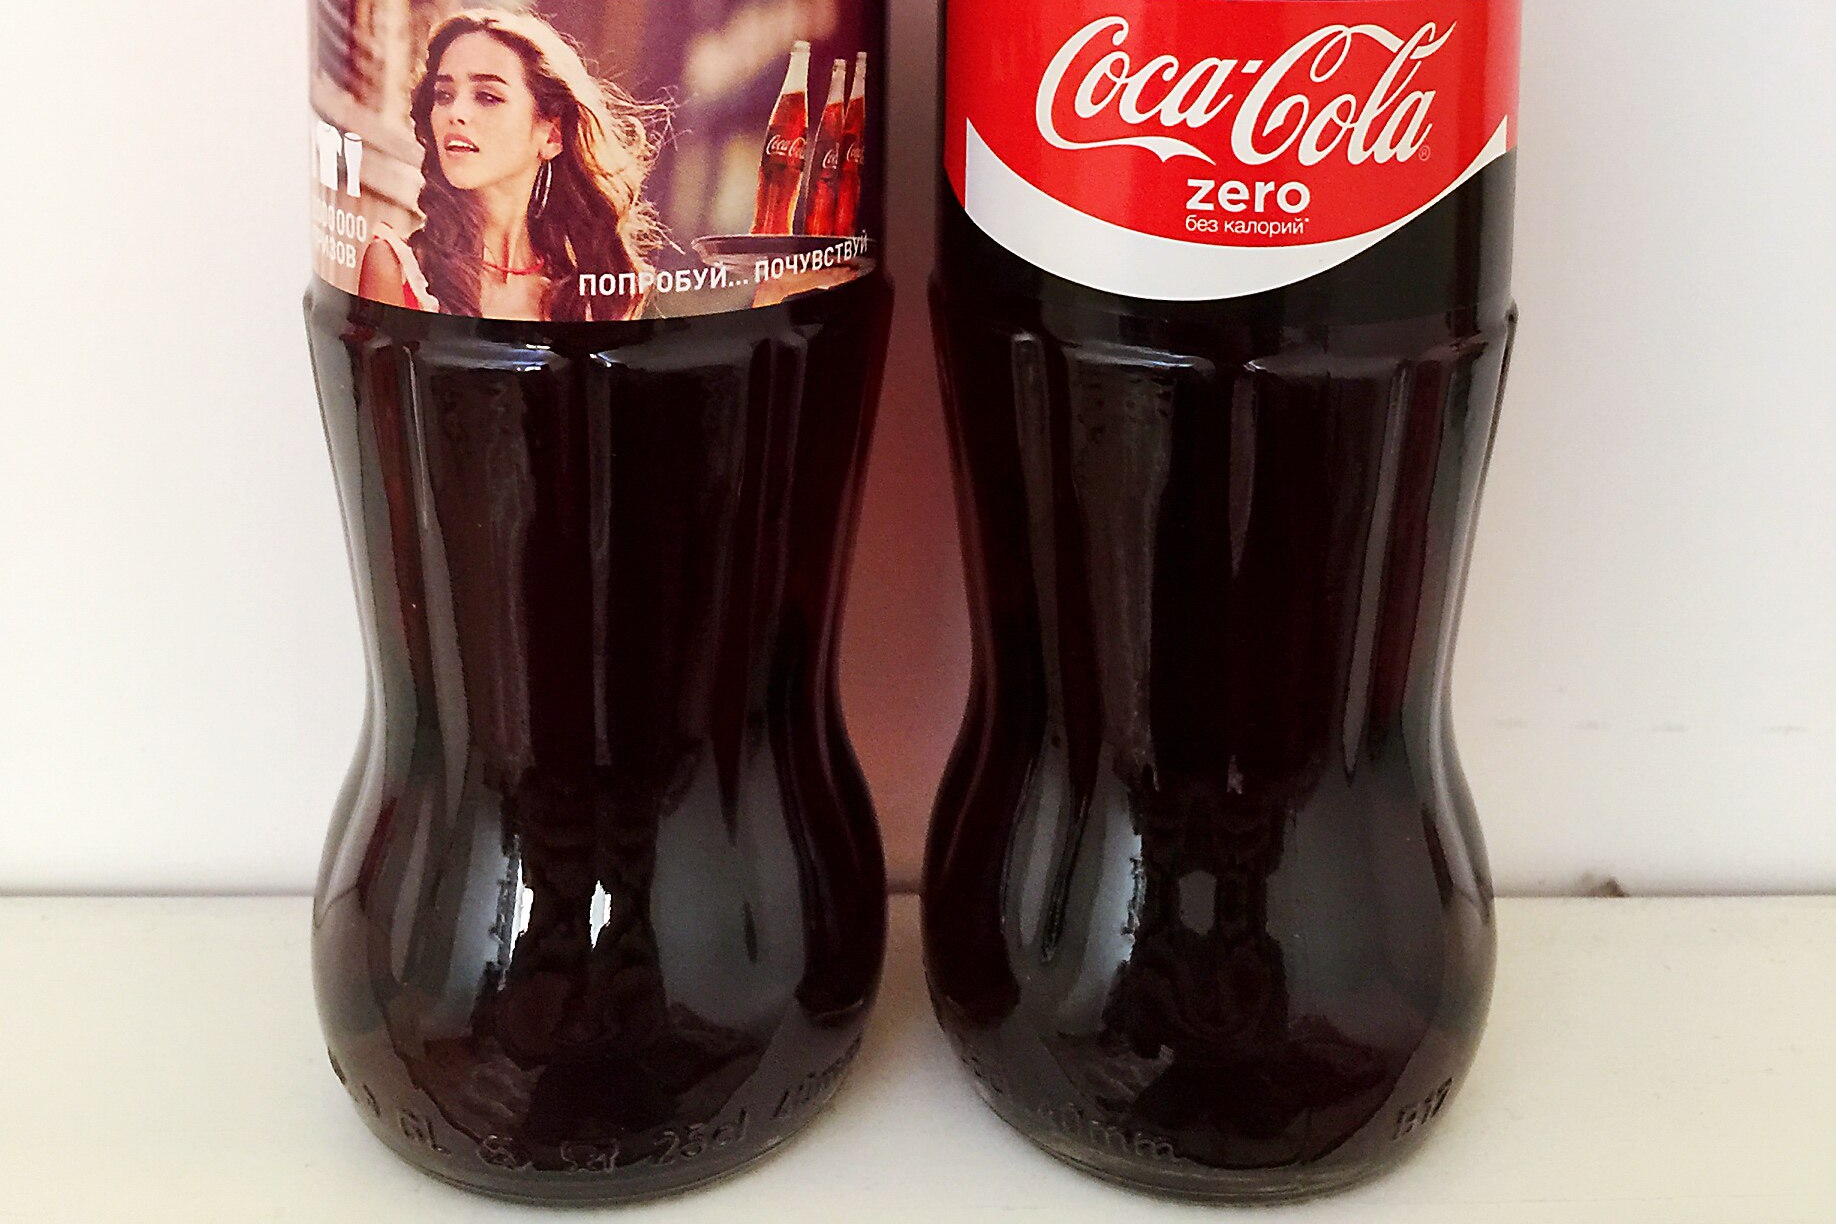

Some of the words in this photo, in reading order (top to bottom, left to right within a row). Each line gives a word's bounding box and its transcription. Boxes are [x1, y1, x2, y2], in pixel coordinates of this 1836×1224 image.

[1035, 15, 1458, 166] Coca-Cola
[1185, 178, 1311, 214] zero
[1185, 214, 1219, 232] без
[578, 261, 750, 297] ПОПРОБУЙ...
[754, 229, 869, 283] ПОЧУВСТВУЙ
